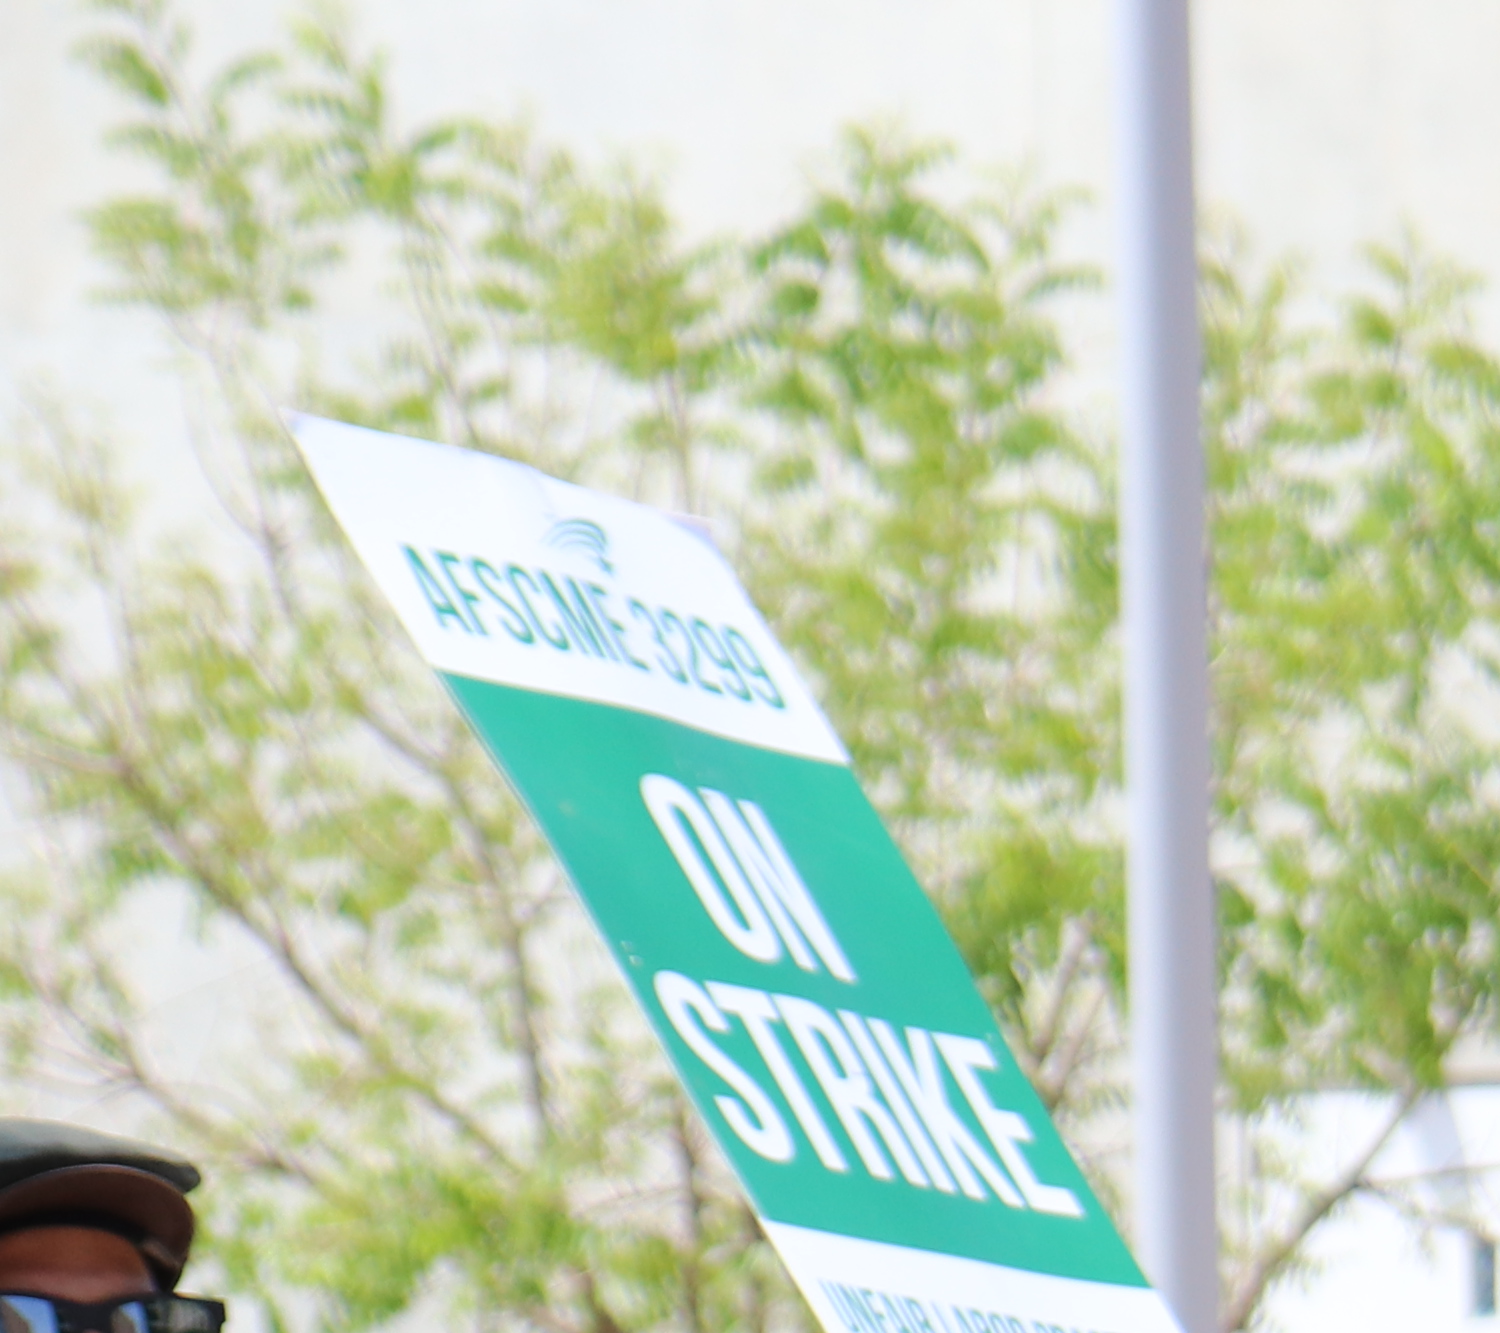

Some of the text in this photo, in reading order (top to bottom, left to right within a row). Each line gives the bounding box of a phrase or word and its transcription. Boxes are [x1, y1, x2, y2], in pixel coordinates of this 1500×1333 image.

[401, 542, 786, 709] AFSCME 3299
[640, 772, 858, 984] ON
[653, 969, 1084, 1217] STRIKE
